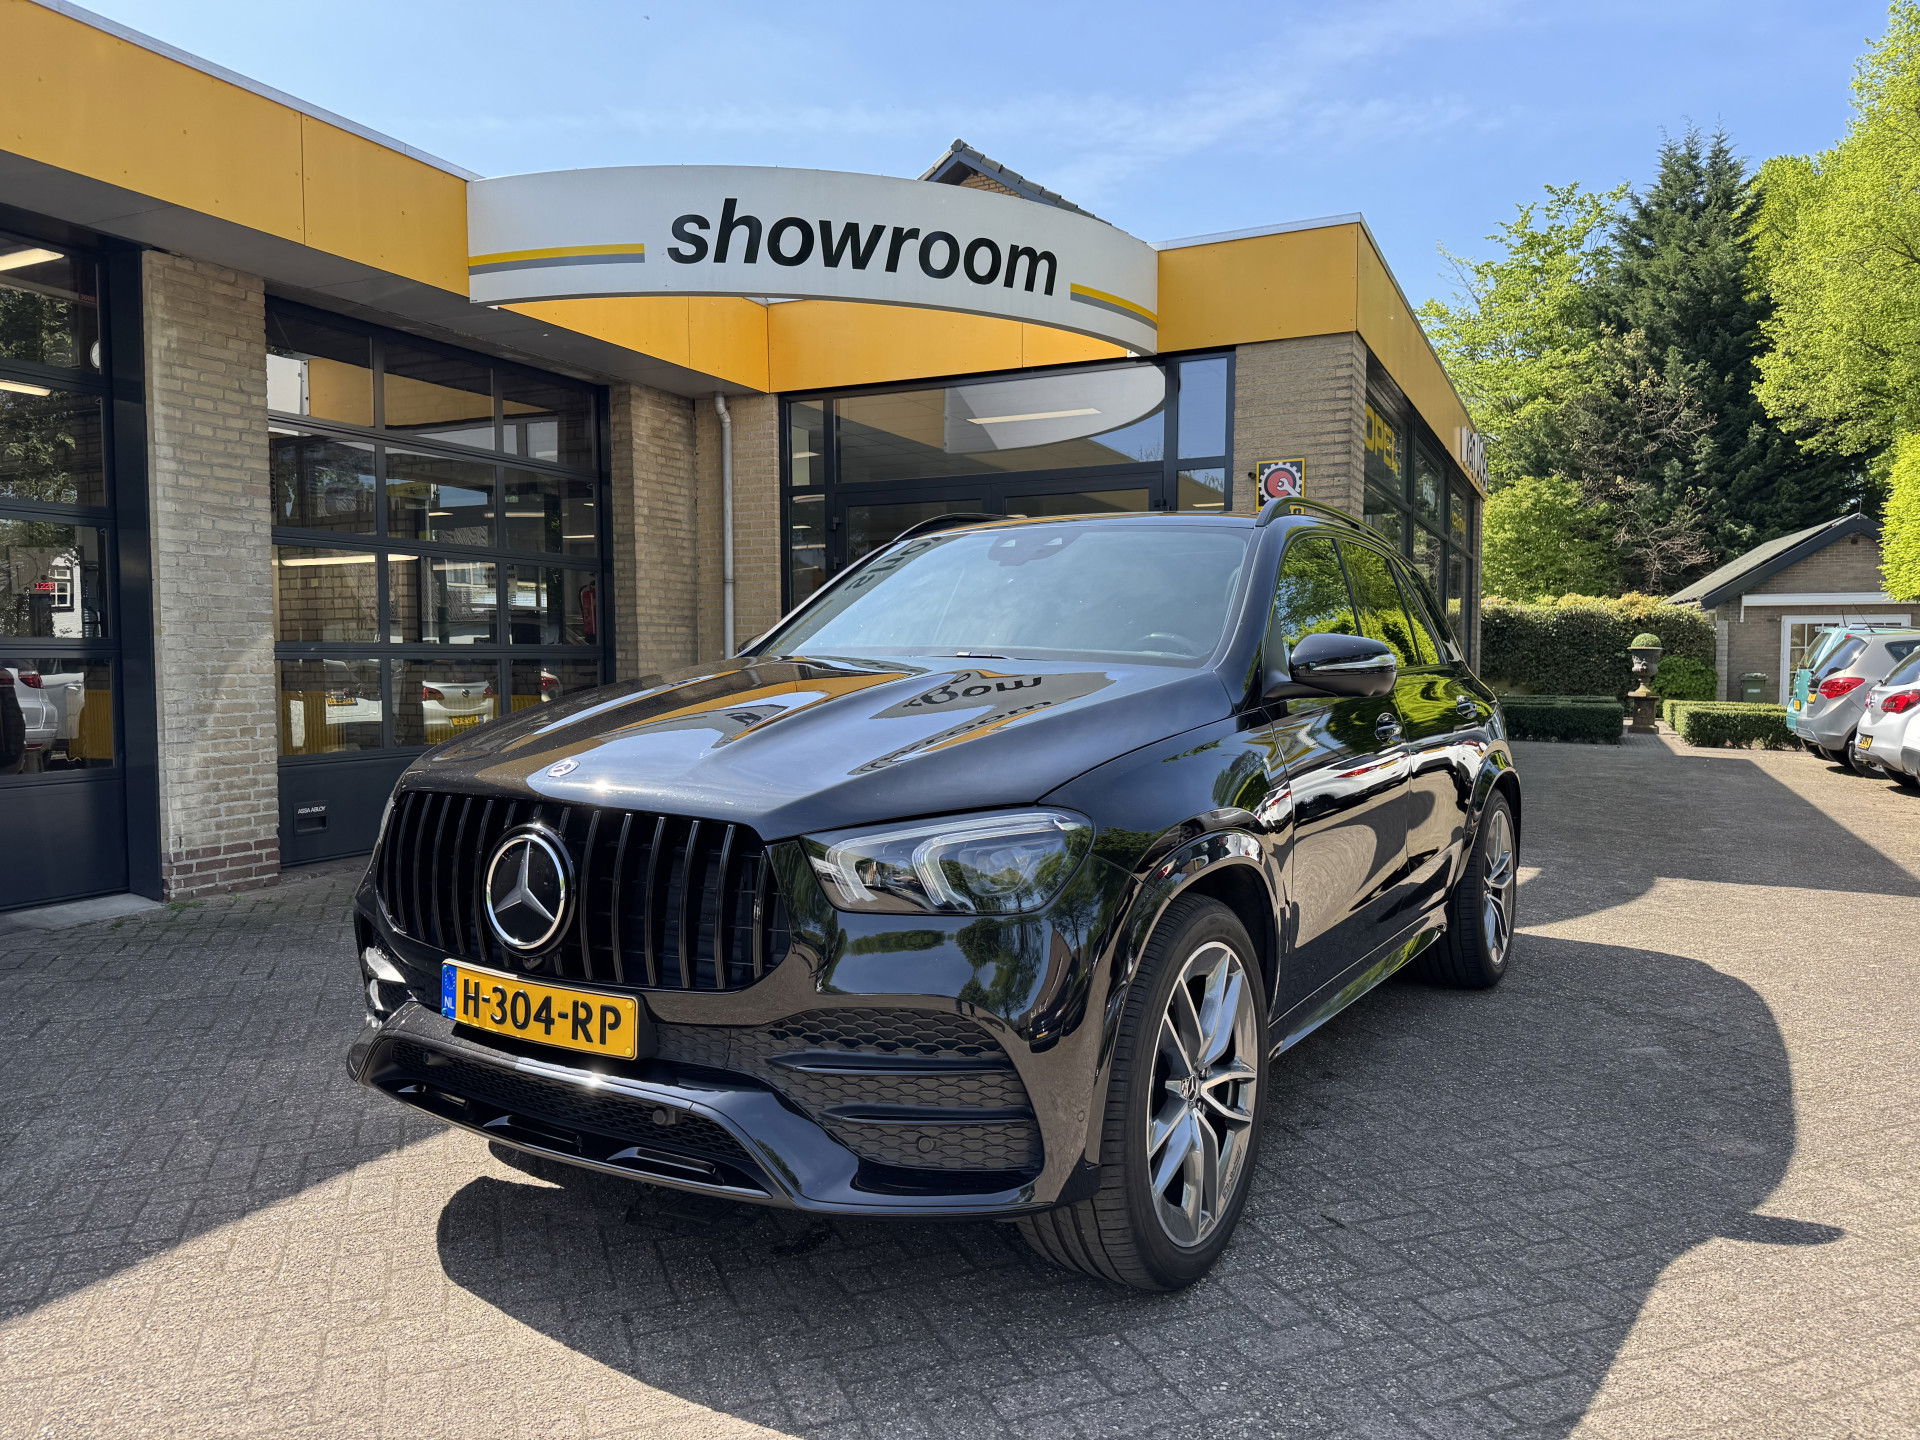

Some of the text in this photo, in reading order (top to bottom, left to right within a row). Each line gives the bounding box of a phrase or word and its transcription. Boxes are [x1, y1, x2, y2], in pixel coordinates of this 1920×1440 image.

[667, 197, 1058, 296] showroom
[1364, 403, 1399, 472] OPEL
[444, 995, 455, 1010] NL
[463, 978, 621, 1045] H-304-RP
